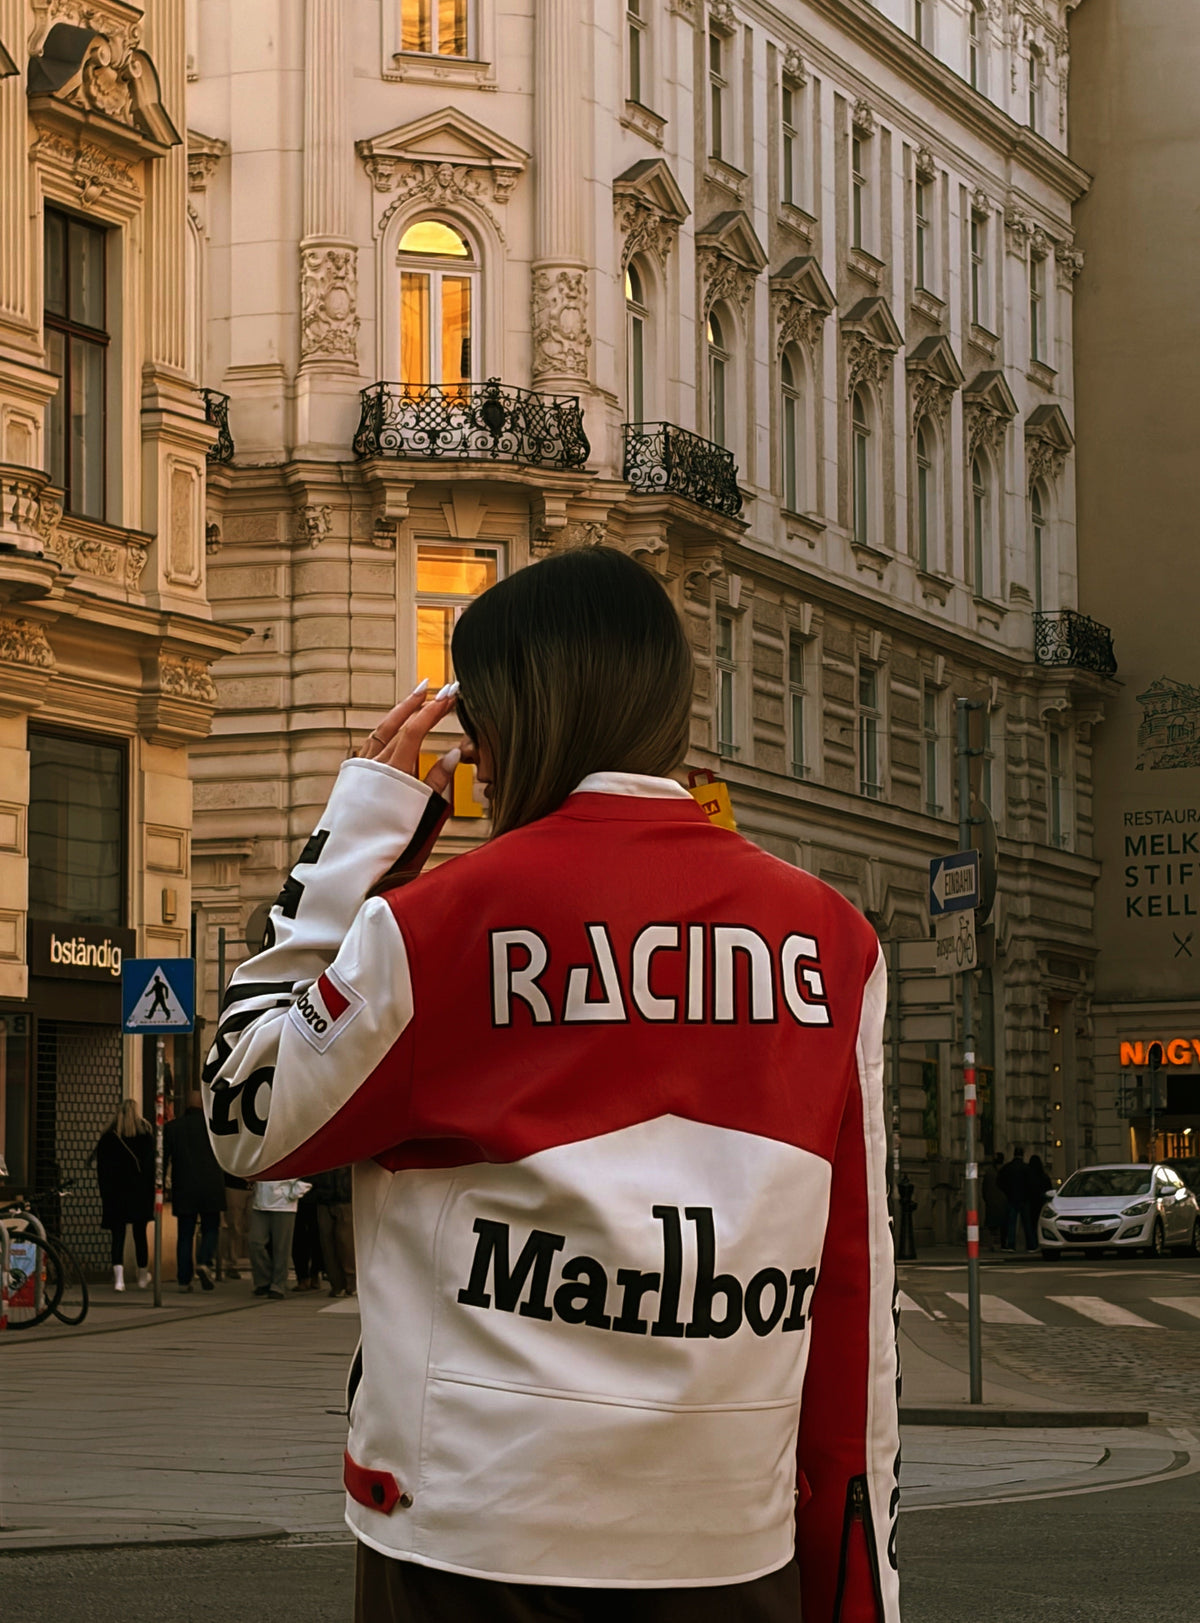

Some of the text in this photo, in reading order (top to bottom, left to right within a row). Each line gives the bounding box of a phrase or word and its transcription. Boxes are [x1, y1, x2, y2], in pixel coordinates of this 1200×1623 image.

[1123, 808, 1200, 826] RESTAUR
[1125, 831, 1200, 857] MELK
[944, 866, 974, 896] EINBAHN
[1125, 863, 1200, 888] STIF
[1126, 893, 1197, 919] KELL
[50, 932, 122, 977] bständig
[488, 921, 834, 1029] RACING
[456, 1204, 817, 1339] Marlbor
